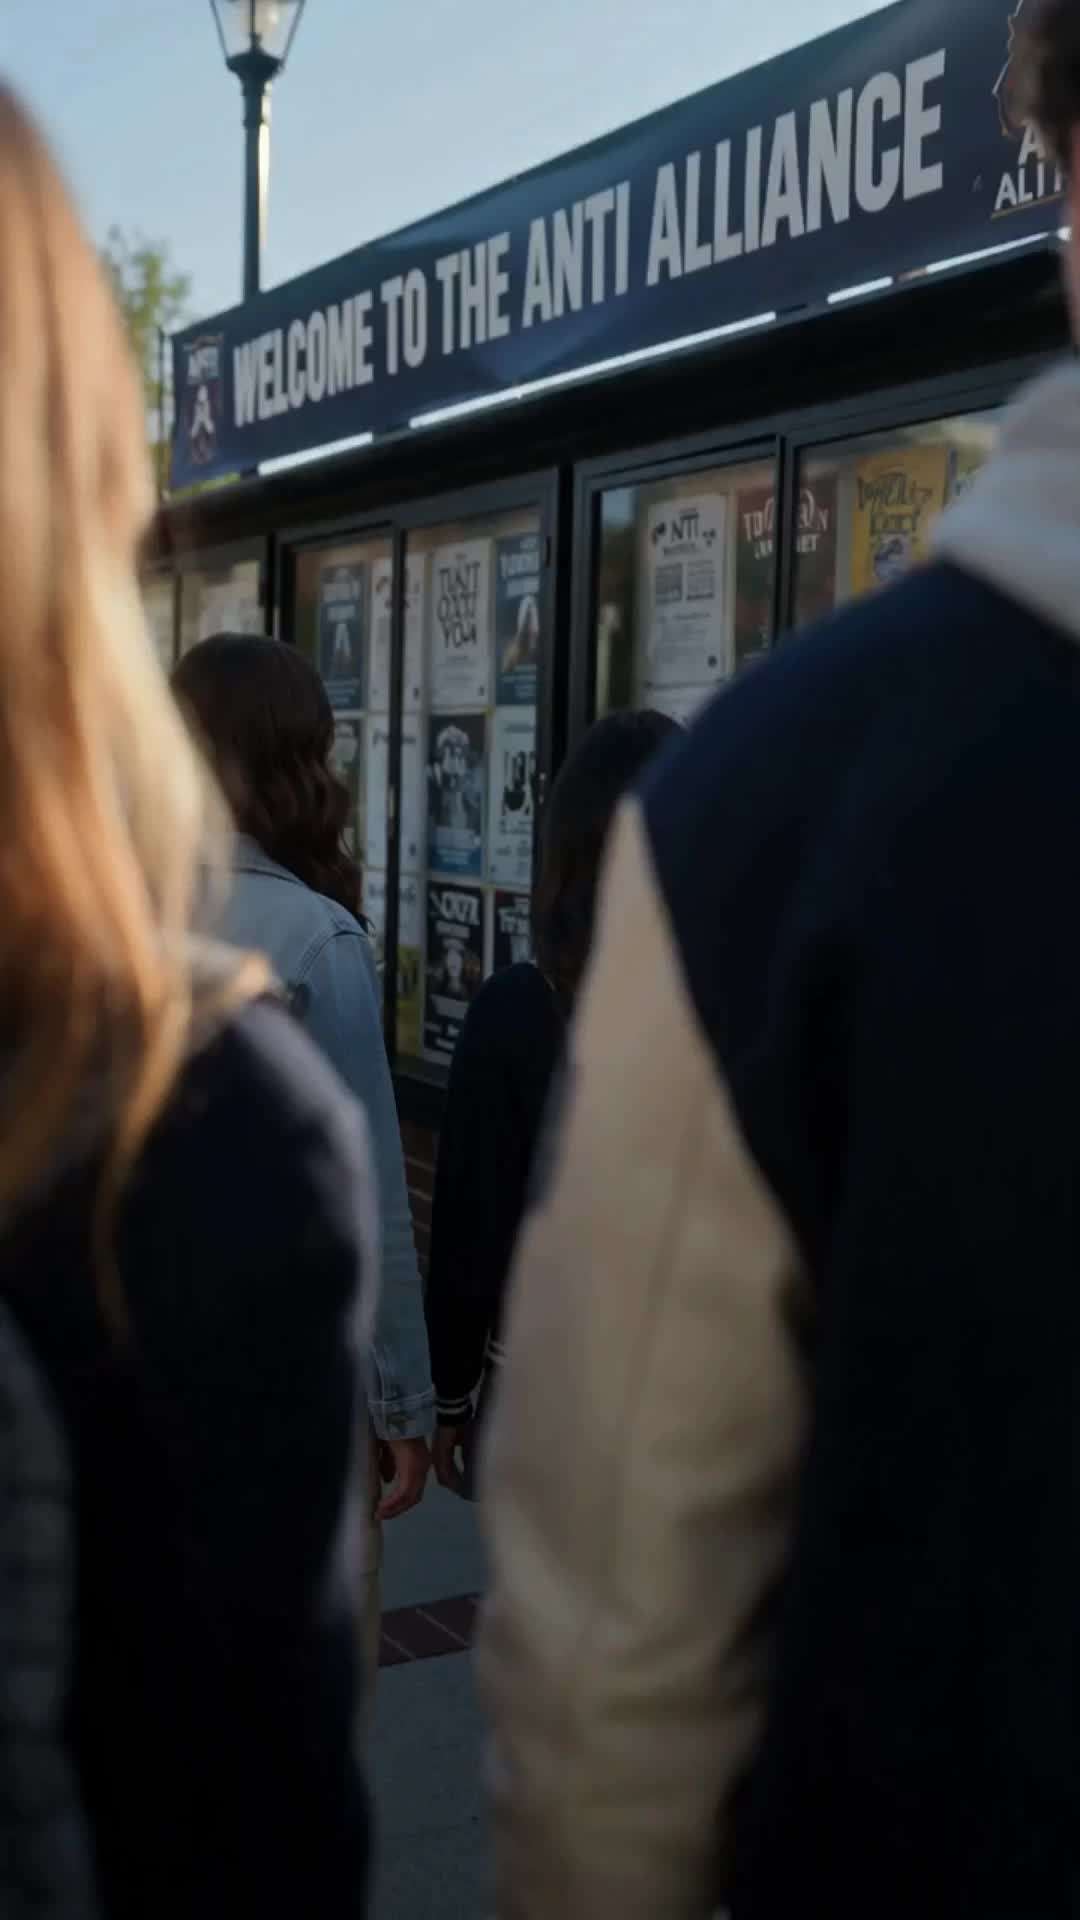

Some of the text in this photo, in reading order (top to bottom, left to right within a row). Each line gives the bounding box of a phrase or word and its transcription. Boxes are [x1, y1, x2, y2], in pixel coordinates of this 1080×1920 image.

[233, 290, 374, 428] WELCOME
[381, 268, 427, 375] TO
[436, 231, 510, 355] THE
[522, 180, 630, 328] ANTI
[646, 48, 945, 287] ALLIANCE
